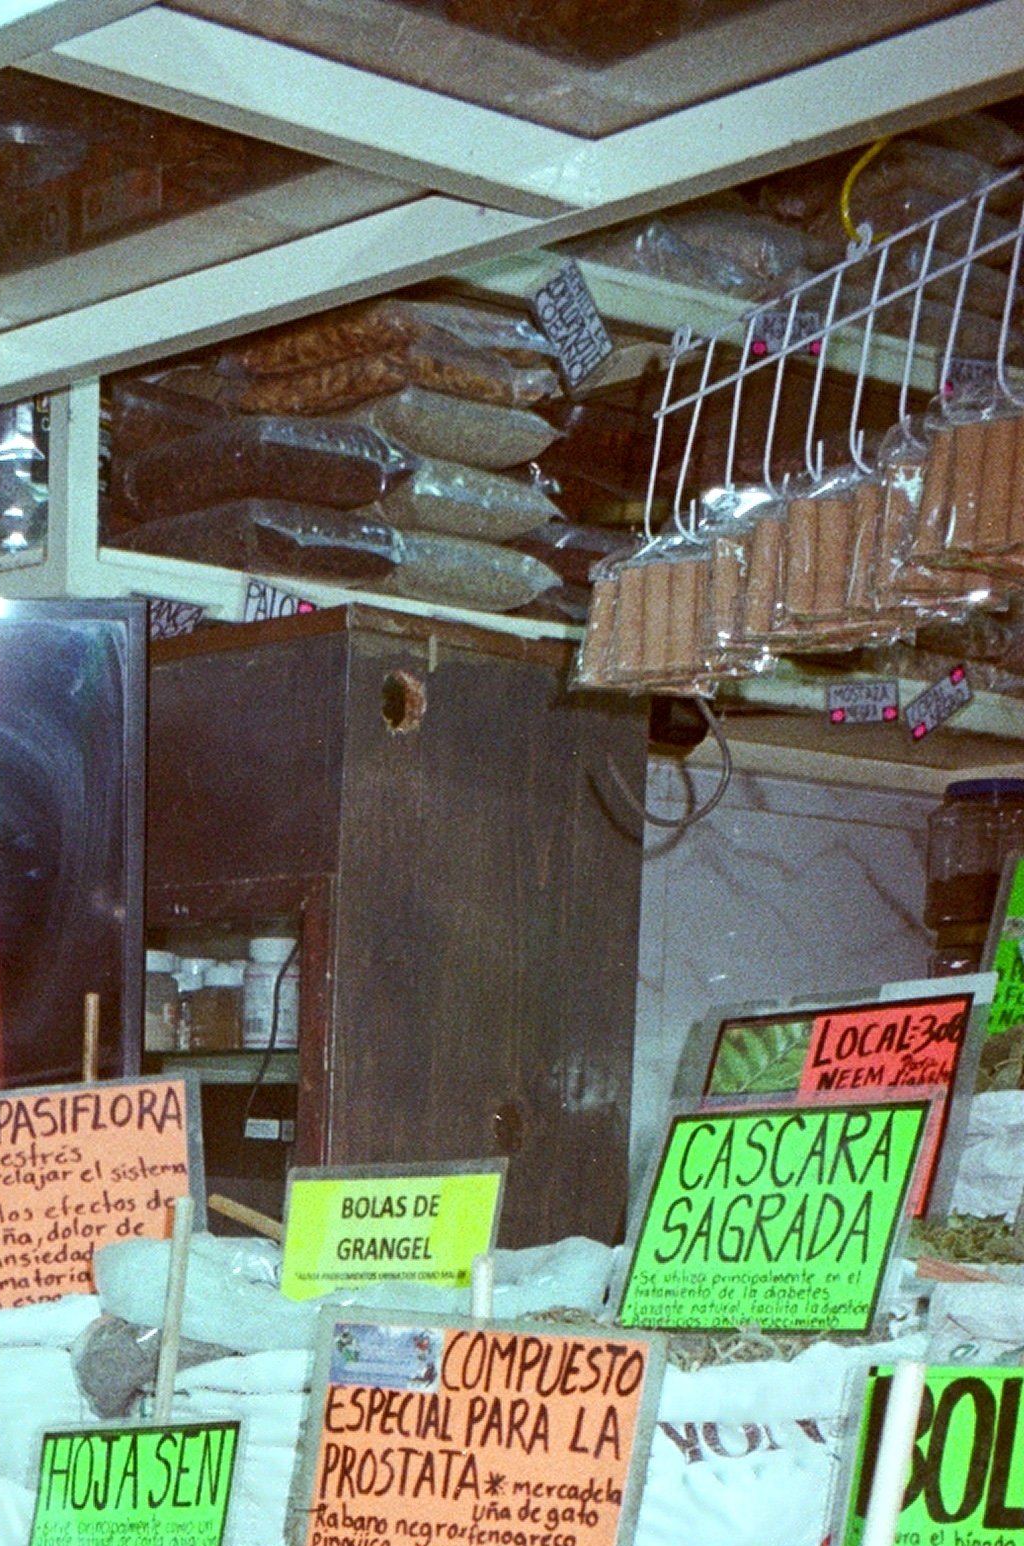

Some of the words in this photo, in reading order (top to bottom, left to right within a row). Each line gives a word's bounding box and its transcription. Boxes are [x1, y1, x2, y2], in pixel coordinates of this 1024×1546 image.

[817, 1065, 884, 1090] NEEM
[679, 1109, 895, 1190] CASCARA
[80, 1161, 102, 1183] el
[111, 1156, 187, 1183] sistema
[44, 1190, 136, 1221] efectos
[146, 1188, 176, 1211] de
[341, 1196, 407, 1219] BOLAS
[413, 1195, 441, 1217] DE
[47, 1217, 107, 1243] dolor
[116, 1217, 144, 1237] de
[654, 1190, 873, 1264] SAGRADA
[337, 1237, 433, 1260] GRANGEL
[712, 1271, 814, 1290] principalmente
[718, 1285, 734, 1299] de
[743, 1284, 757, 1299] la
[764, 1284, 829, 1301] diabetes
[441, 1331, 645, 1397] COMPUESTO
[326, 1387, 453, 1441] ESPECIAL
[465, 1397, 550, 1455] PARA
[570, 1405, 621, 1460] LA
[45, 1434, 138, 1511] HOJA
[147, 1430, 226, 1509] SEN
[320, 1443, 480, 1501] PROSTATA
[518, 1499, 541, 1521] de
[545, 1500, 599, 1531] gato
[930, 1529, 944, 1546] el
